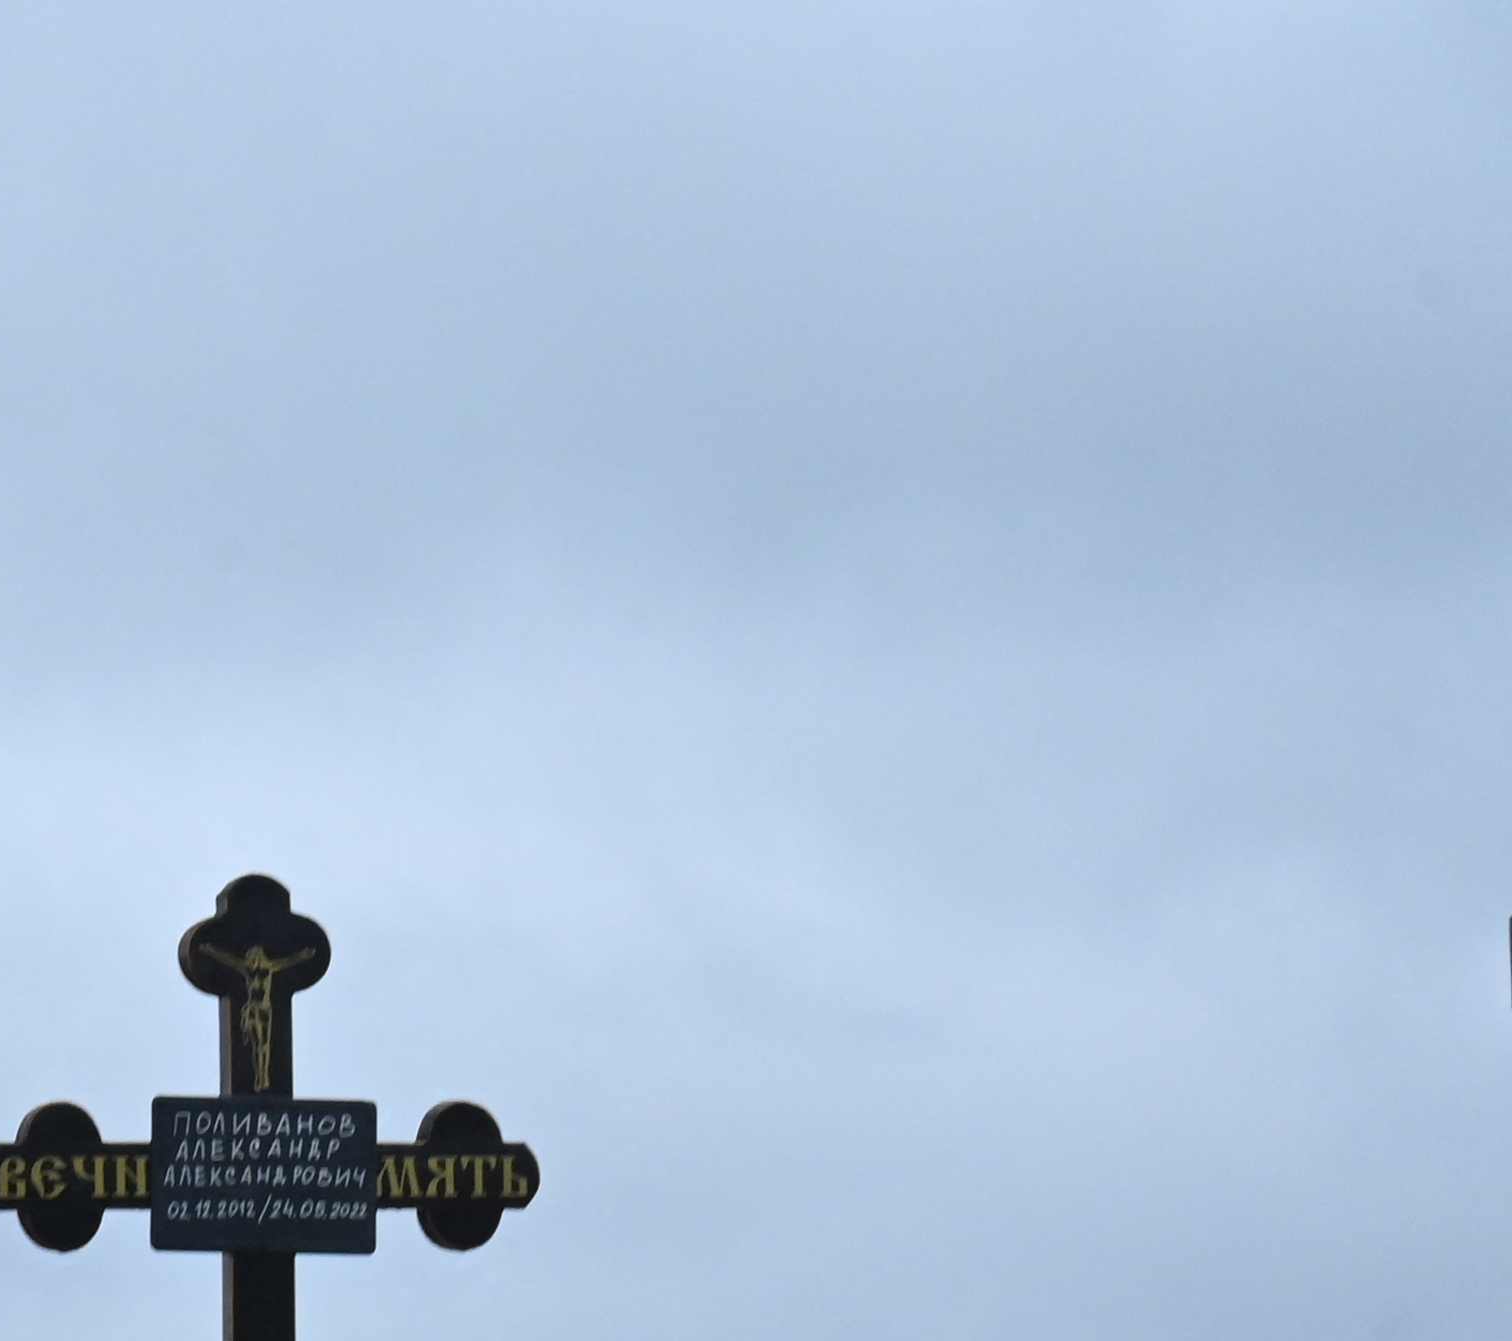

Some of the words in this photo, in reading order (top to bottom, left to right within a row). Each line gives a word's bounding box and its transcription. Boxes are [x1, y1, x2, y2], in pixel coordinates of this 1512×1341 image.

[173, 1110, 357, 1139] ПОЛИВАНОВ
[175, 1137, 341, 1162] АЛЕКСАНДР
[163, 1163, 368, 1190] АЛЕКСАНДРОВИЧ
